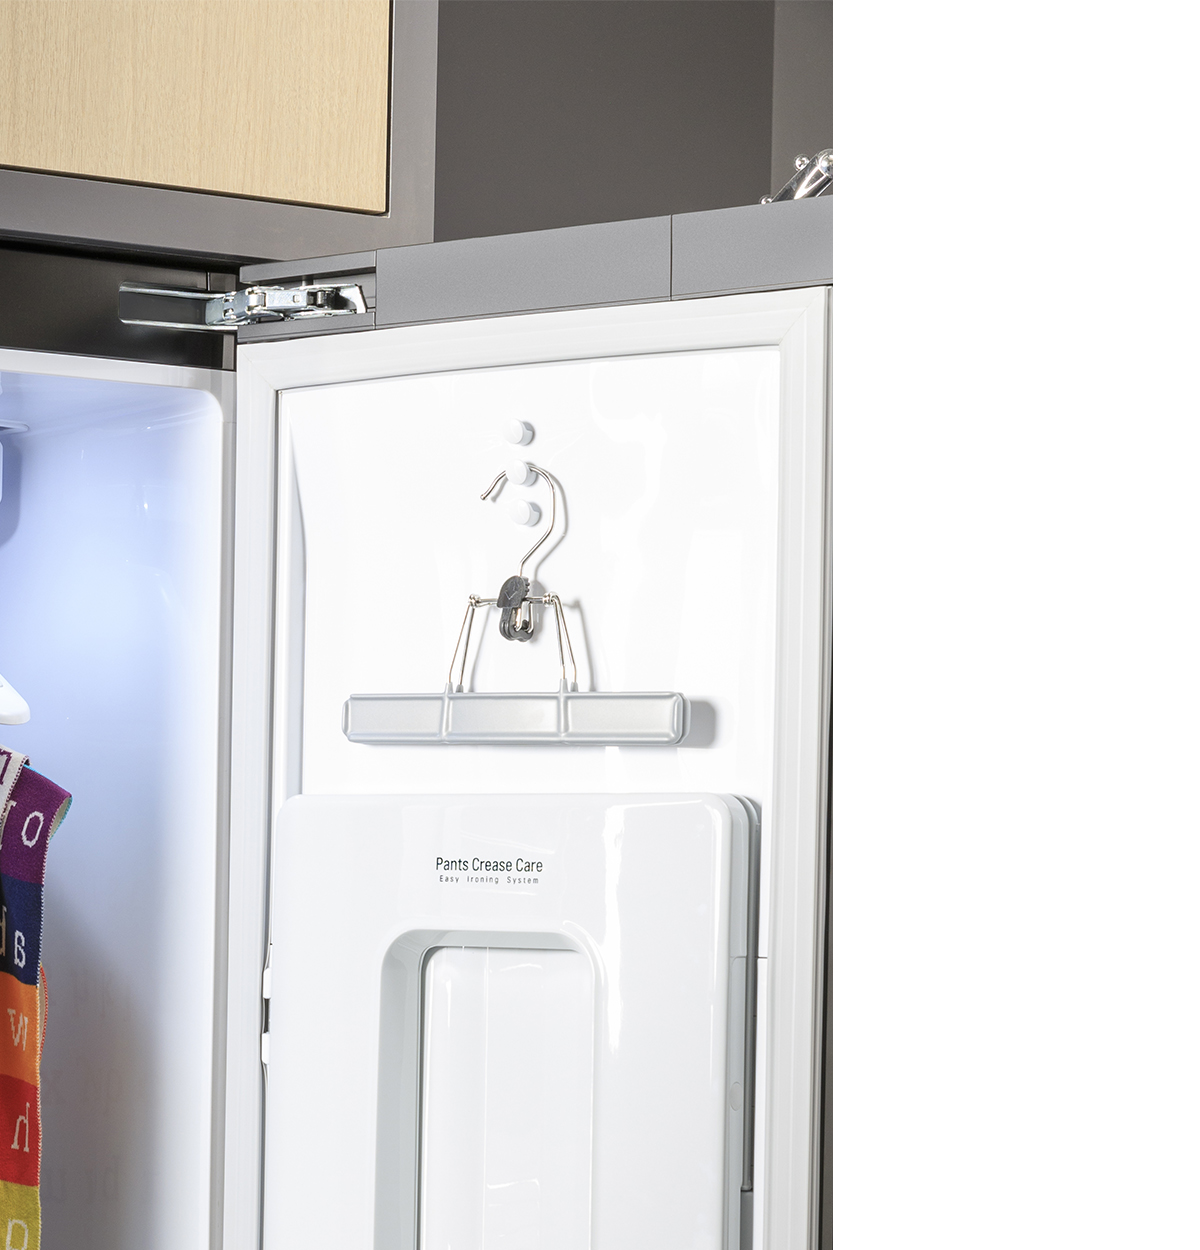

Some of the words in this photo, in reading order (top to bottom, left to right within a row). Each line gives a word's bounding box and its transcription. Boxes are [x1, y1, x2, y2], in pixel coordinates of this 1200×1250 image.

[435, 856, 469, 871] Pants
[471, 857, 513, 872] Crease
[515, 858, 544, 873] Care
[439, 874, 460, 884] Easy
[466, 875, 500, 885] Ironing
[506, 876, 539, 885] System
